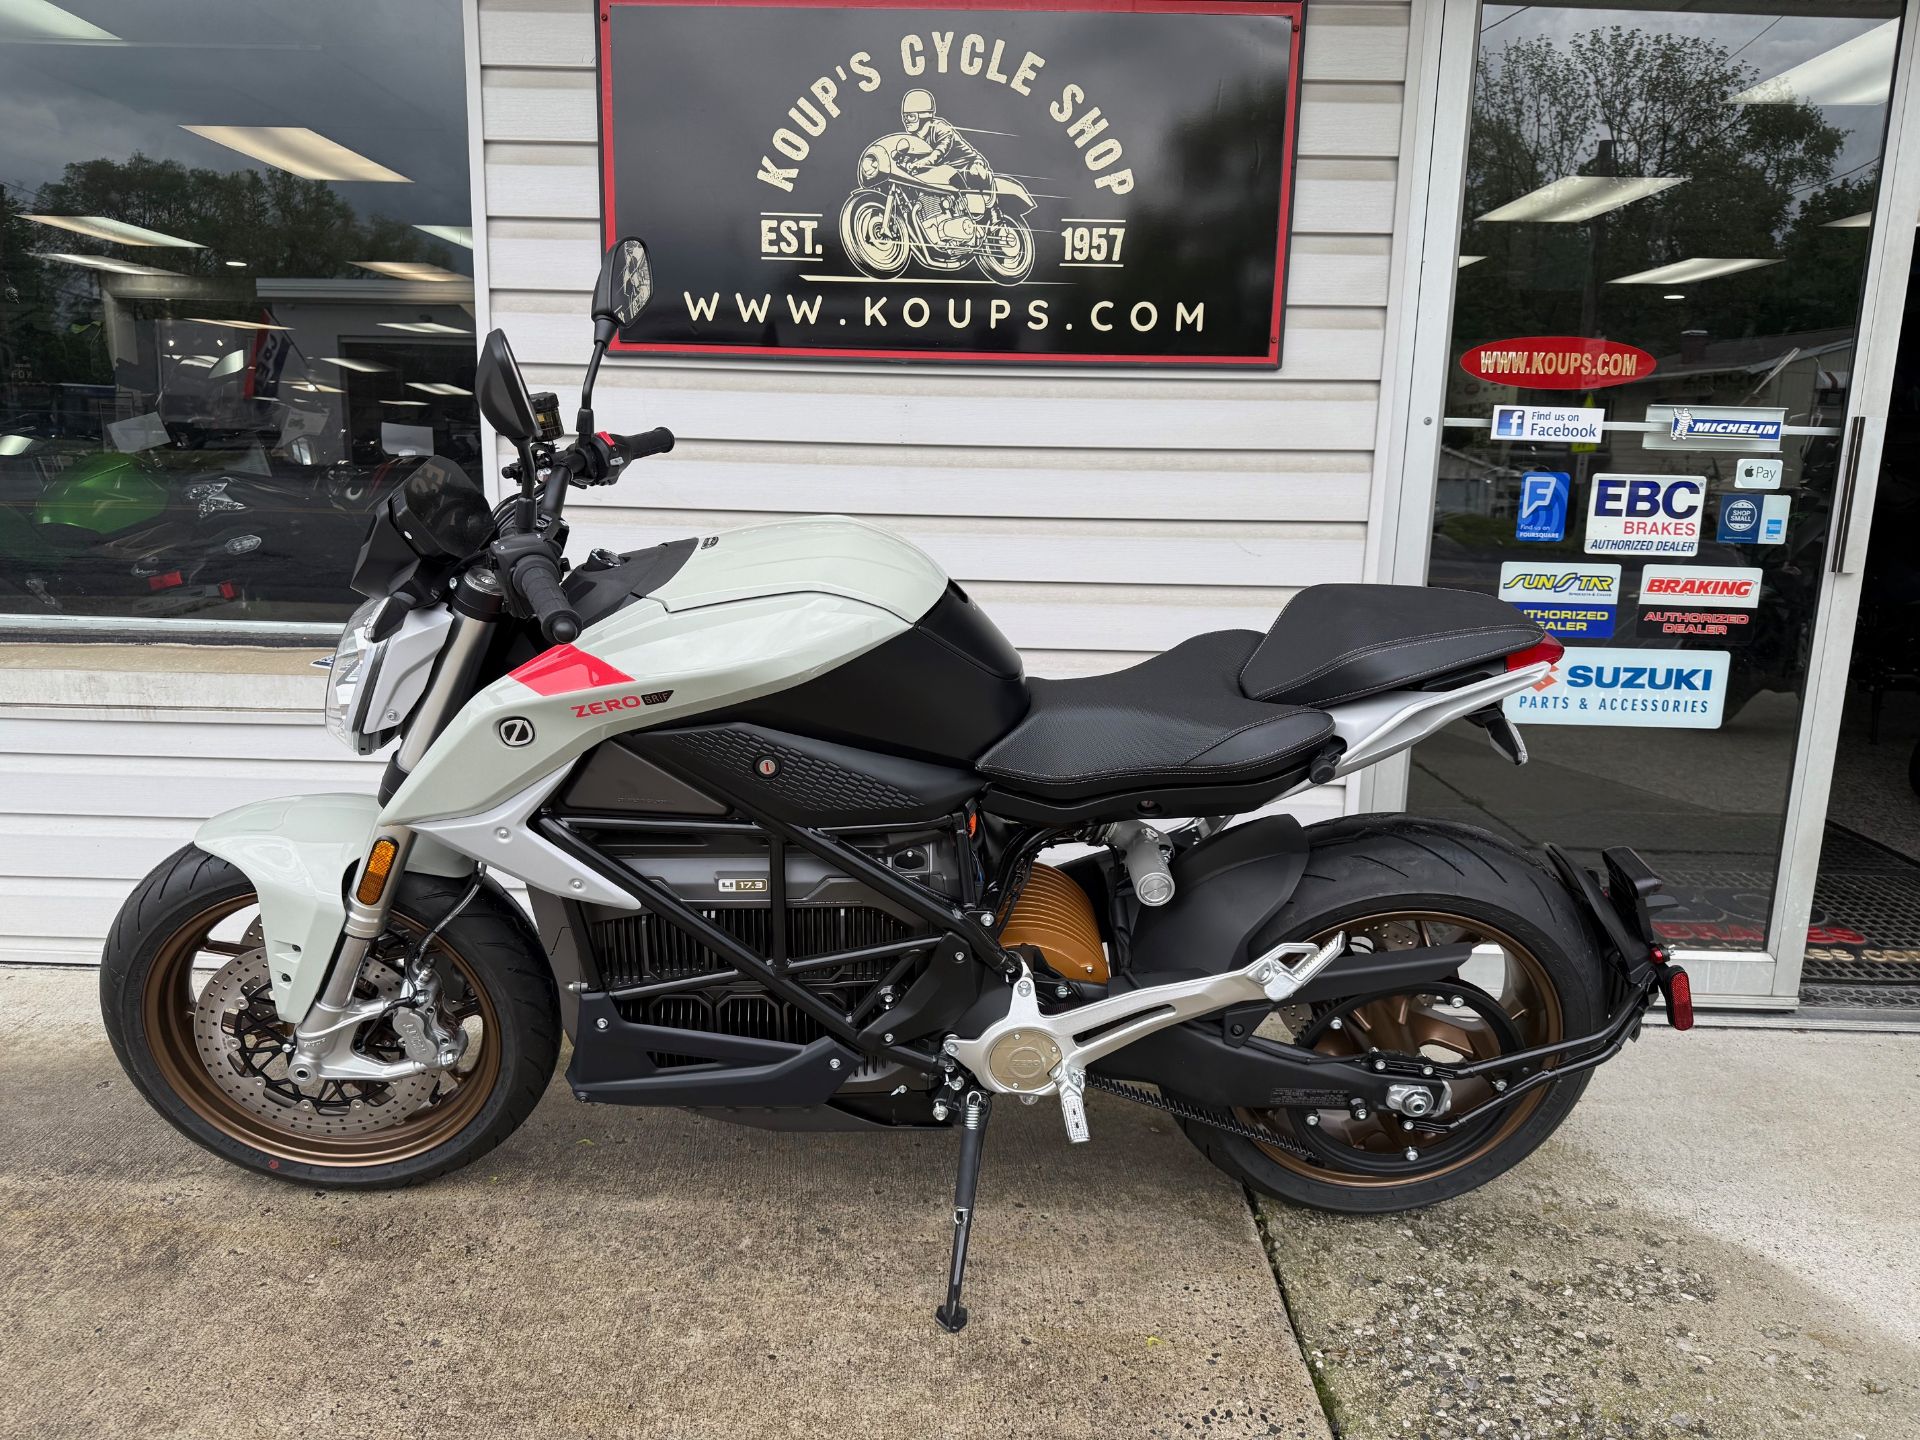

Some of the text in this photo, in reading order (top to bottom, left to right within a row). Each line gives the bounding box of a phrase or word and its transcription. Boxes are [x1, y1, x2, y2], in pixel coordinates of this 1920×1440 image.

[756, 31, 1135, 196] KOUP'S CYCLE SHOP
[760, 219, 823, 254] EST.
[1061, 227, 1126, 262] 1957
[683, 291, 1205, 332] WWW.KOUPS.COM
[1480, 351, 1638, 376] WWW.KOUPS.COM
[1531, 411, 1579, 422] Find us on
[1530, 423, 1597, 438] Facebook
[1692, 421, 1778, 436] MICHELIN
[1755, 466, 1776, 482] Pay
[1594, 479, 1701, 520] EBC
[1730, 515, 1751, 523] SMALL
[1732, 509, 1751, 517] SHOP
[1623, 521, 1696, 536] BRAKES
[1590, 539, 1695, 552] AUTHORIZED DEALER
[1503, 572, 1614, 593] SUNSTAR
[1645, 578, 1753, 597] BRAKING
[1523, 609, 1609, 620] THORIZED
[1643, 611, 1750, 625] AUTHORIZED
[1535, 621, 1588, 631] EALER
[1662, 622, 1728, 635] DEALER
[1566, 665, 1713, 691] SUZUKI
[570, 695, 641, 718] ZERO
[1519, 695, 1709, 713] PARTS & ACCESSORIES
[739, 881, 763, 889] 17.3
